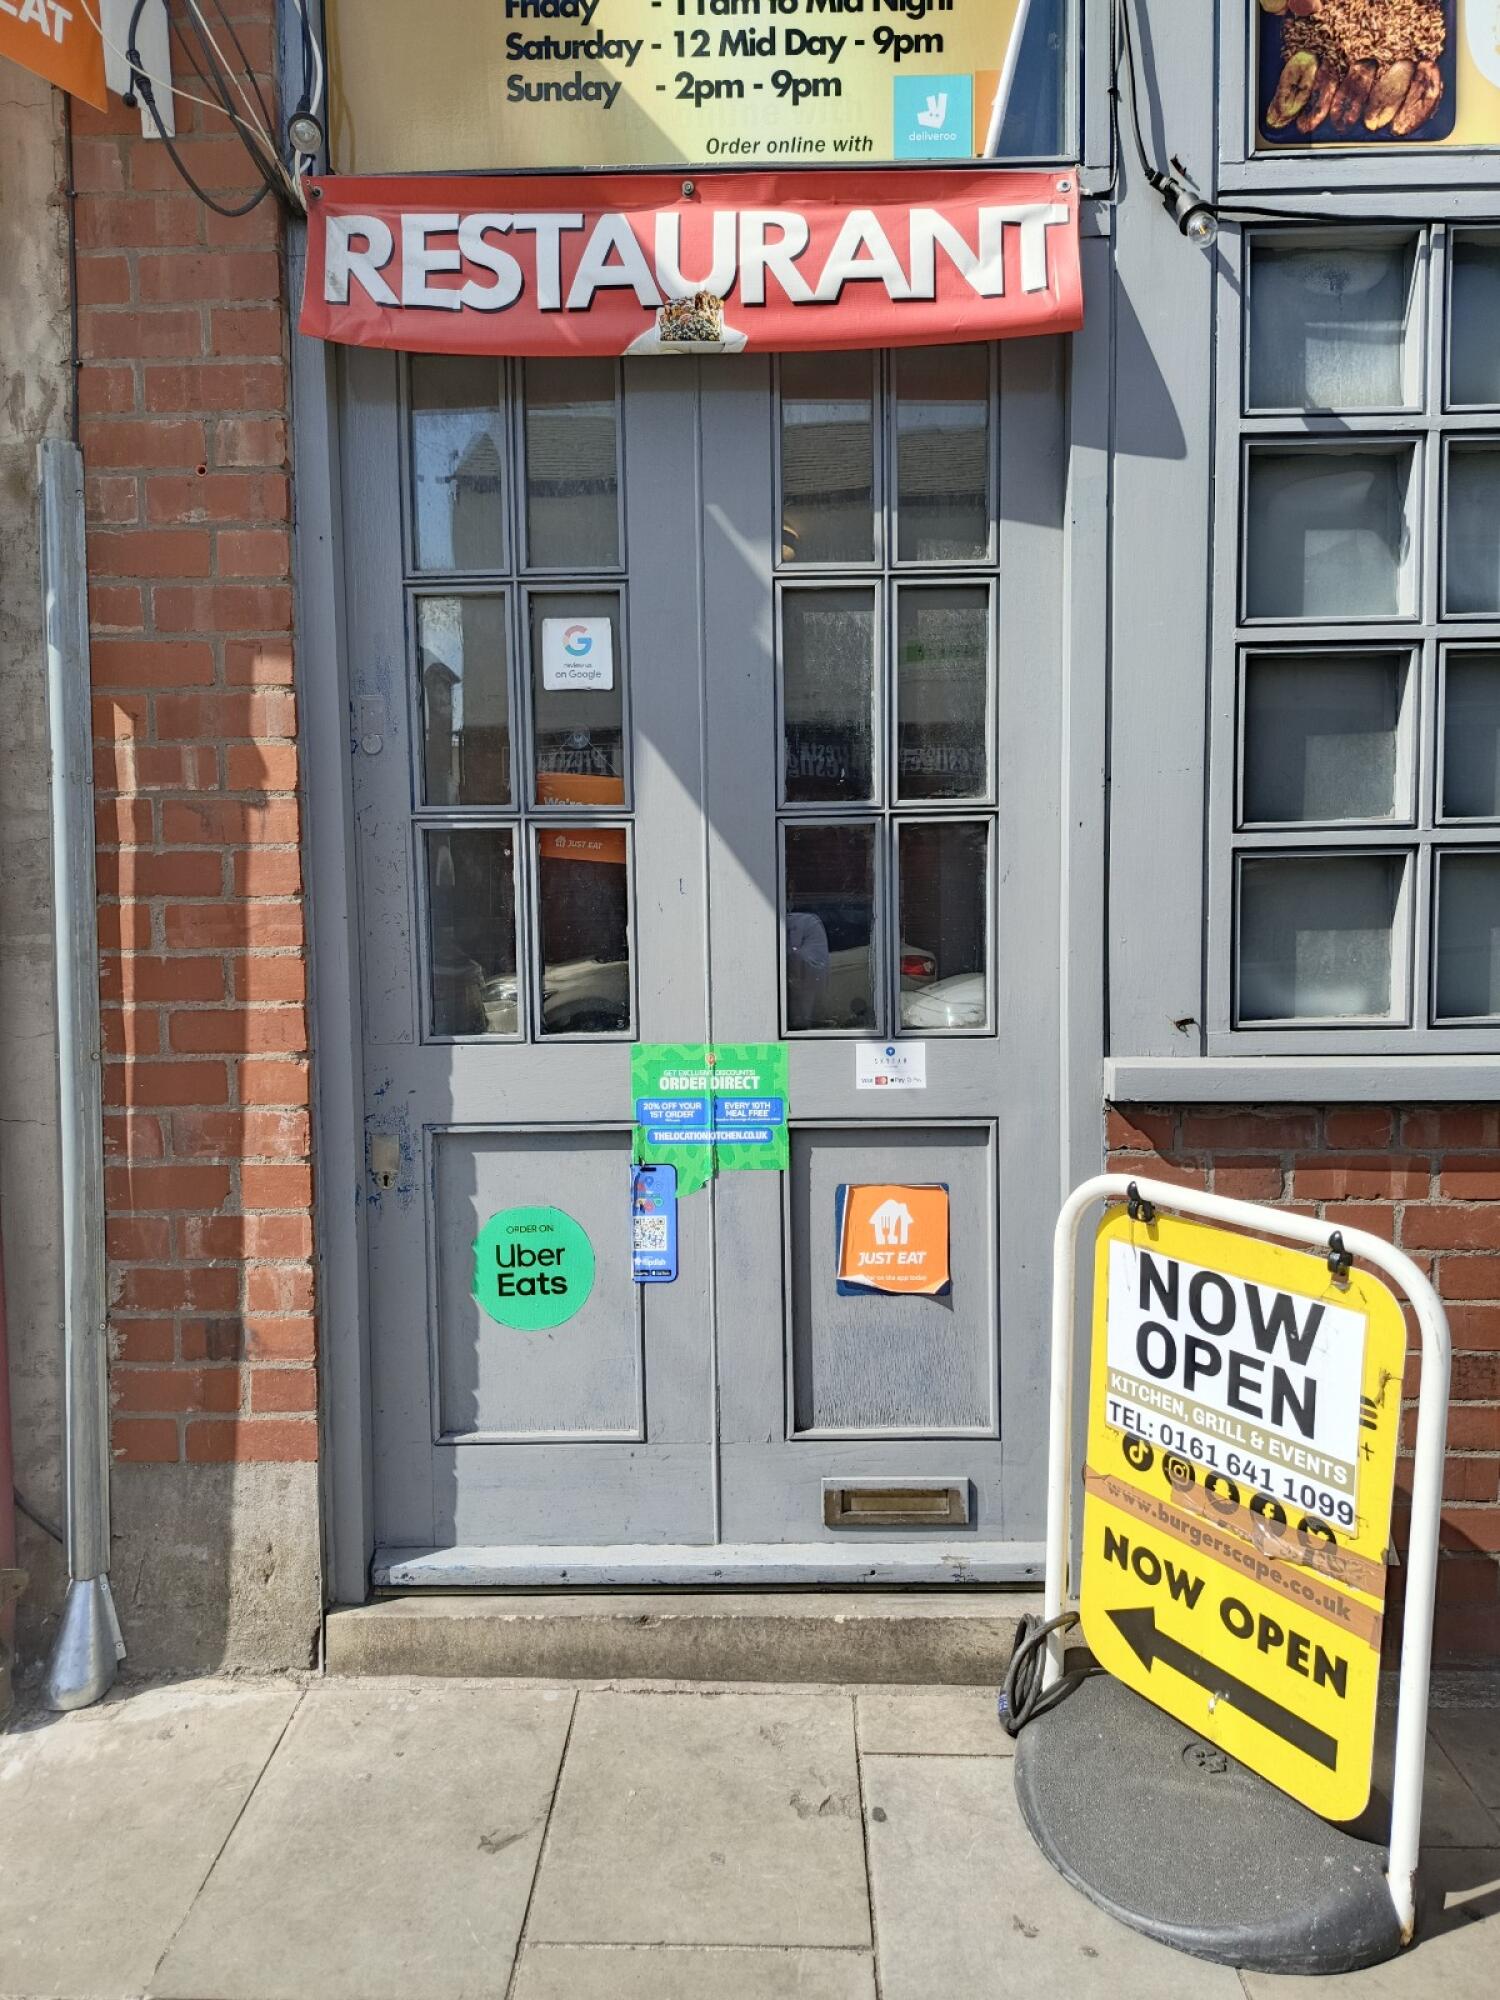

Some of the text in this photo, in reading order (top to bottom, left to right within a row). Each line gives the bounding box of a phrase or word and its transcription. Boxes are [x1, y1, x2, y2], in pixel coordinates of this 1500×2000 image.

[505, 0, 600, 25] Friday
[506, 29, 644, 67] Saturday
[674, 30, 711, 57] 12
[718, 26, 776, 57] Mid
[785, 28, 847, 64] Day
[873, 26, 944, 62] 9pm
[507, 71, 622, 109] Sunday
[675, 71, 744, 108] 2pm
[771, 70, 842, 106] 9pm
[706, 136, 873, 155] Order online with
[908, 131, 957, 141] deliveroo
[324, 203, 1070, 312] RESTAURANT
[555, 669, 602, 680] on Google
[659, 1076, 760, 1090] ORDER DIRECT
[662, 1102, 677, 1110] OFF
[679, 1102, 702, 1110] YOUR
[724, 1102, 750, 1110] EVERY
[725, 1109, 746, 1117] MEAL
[506, 1224, 554, 1234] ORDER ON
[496, 1243, 565, 1268] Uber
[857, 1250, 928, 1266] JUST EAT
[498, 1272, 568, 1297] Eats
[1139, 1251, 1326, 1366] NOW
[1136, 1320, 1317, 1440] OPEN
[1111, 1372, 1347, 1484] KITCHEN, GRILL & EVENTS
[1108, 1401, 1354, 1526] TEL: 0161 641 1099
[1107, 1482, 1352, 1621] www.burgerscape.co.uk
[1103, 1526, 1205, 1610] NOW
[1219, 1597, 1348, 1699] OPEN
